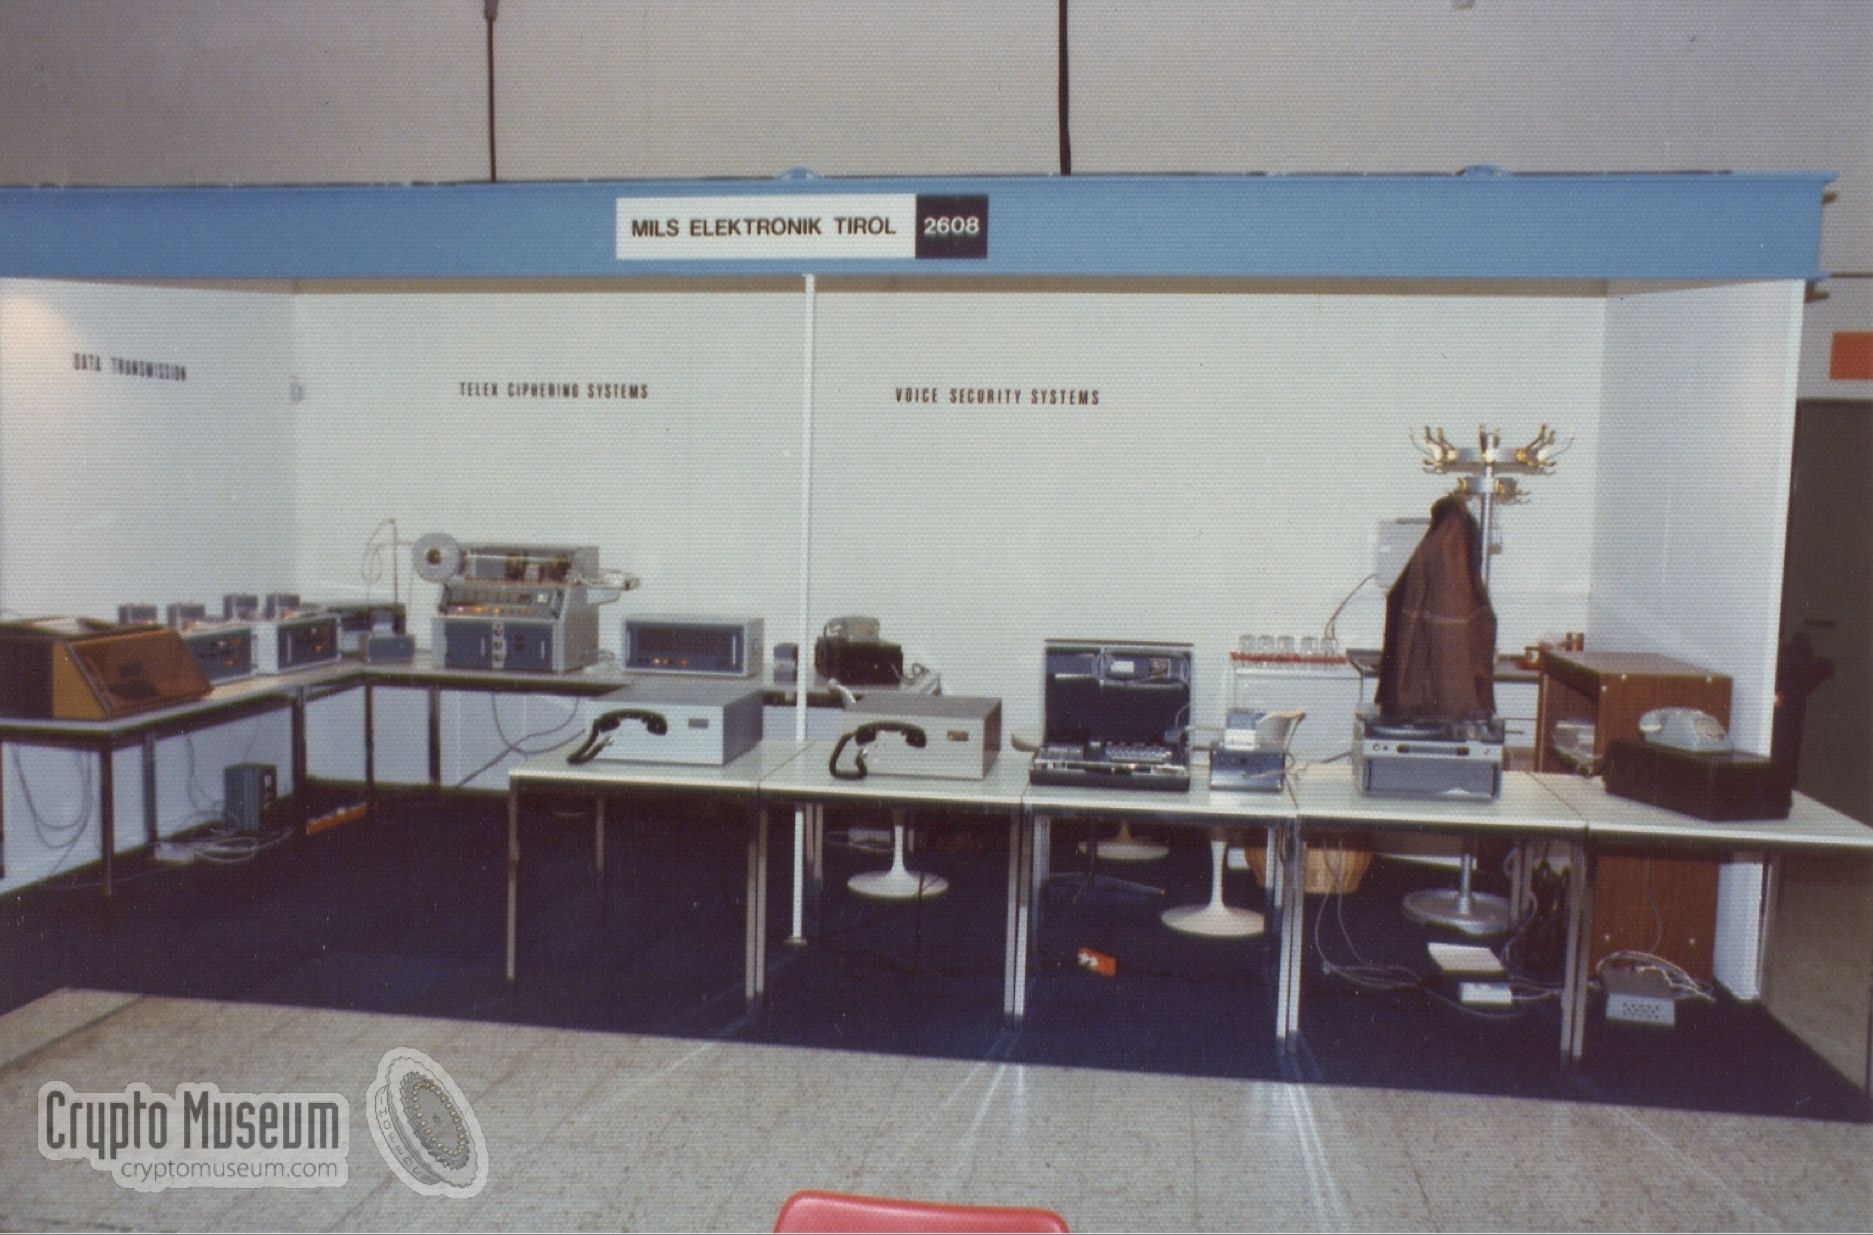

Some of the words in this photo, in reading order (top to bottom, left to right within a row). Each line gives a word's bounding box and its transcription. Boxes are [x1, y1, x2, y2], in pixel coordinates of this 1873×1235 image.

[631, 219, 680, 238] MILS
[689, 217, 822, 237] ELEKTRONIK
[834, 216, 896, 235] TIROL
[923, 216, 980, 235] 2608
[74, 352, 101, 371] DATA
[459, 382, 498, 397] TELEX
[508, 382, 579, 398] CIPHERING
[587, 383, 649, 399] SYSTEMS
[896, 387, 938, 404] VOICE
[949, 388, 1022, 405] SECURITY
[1031, 389, 1100, 405] SYSTEMS
